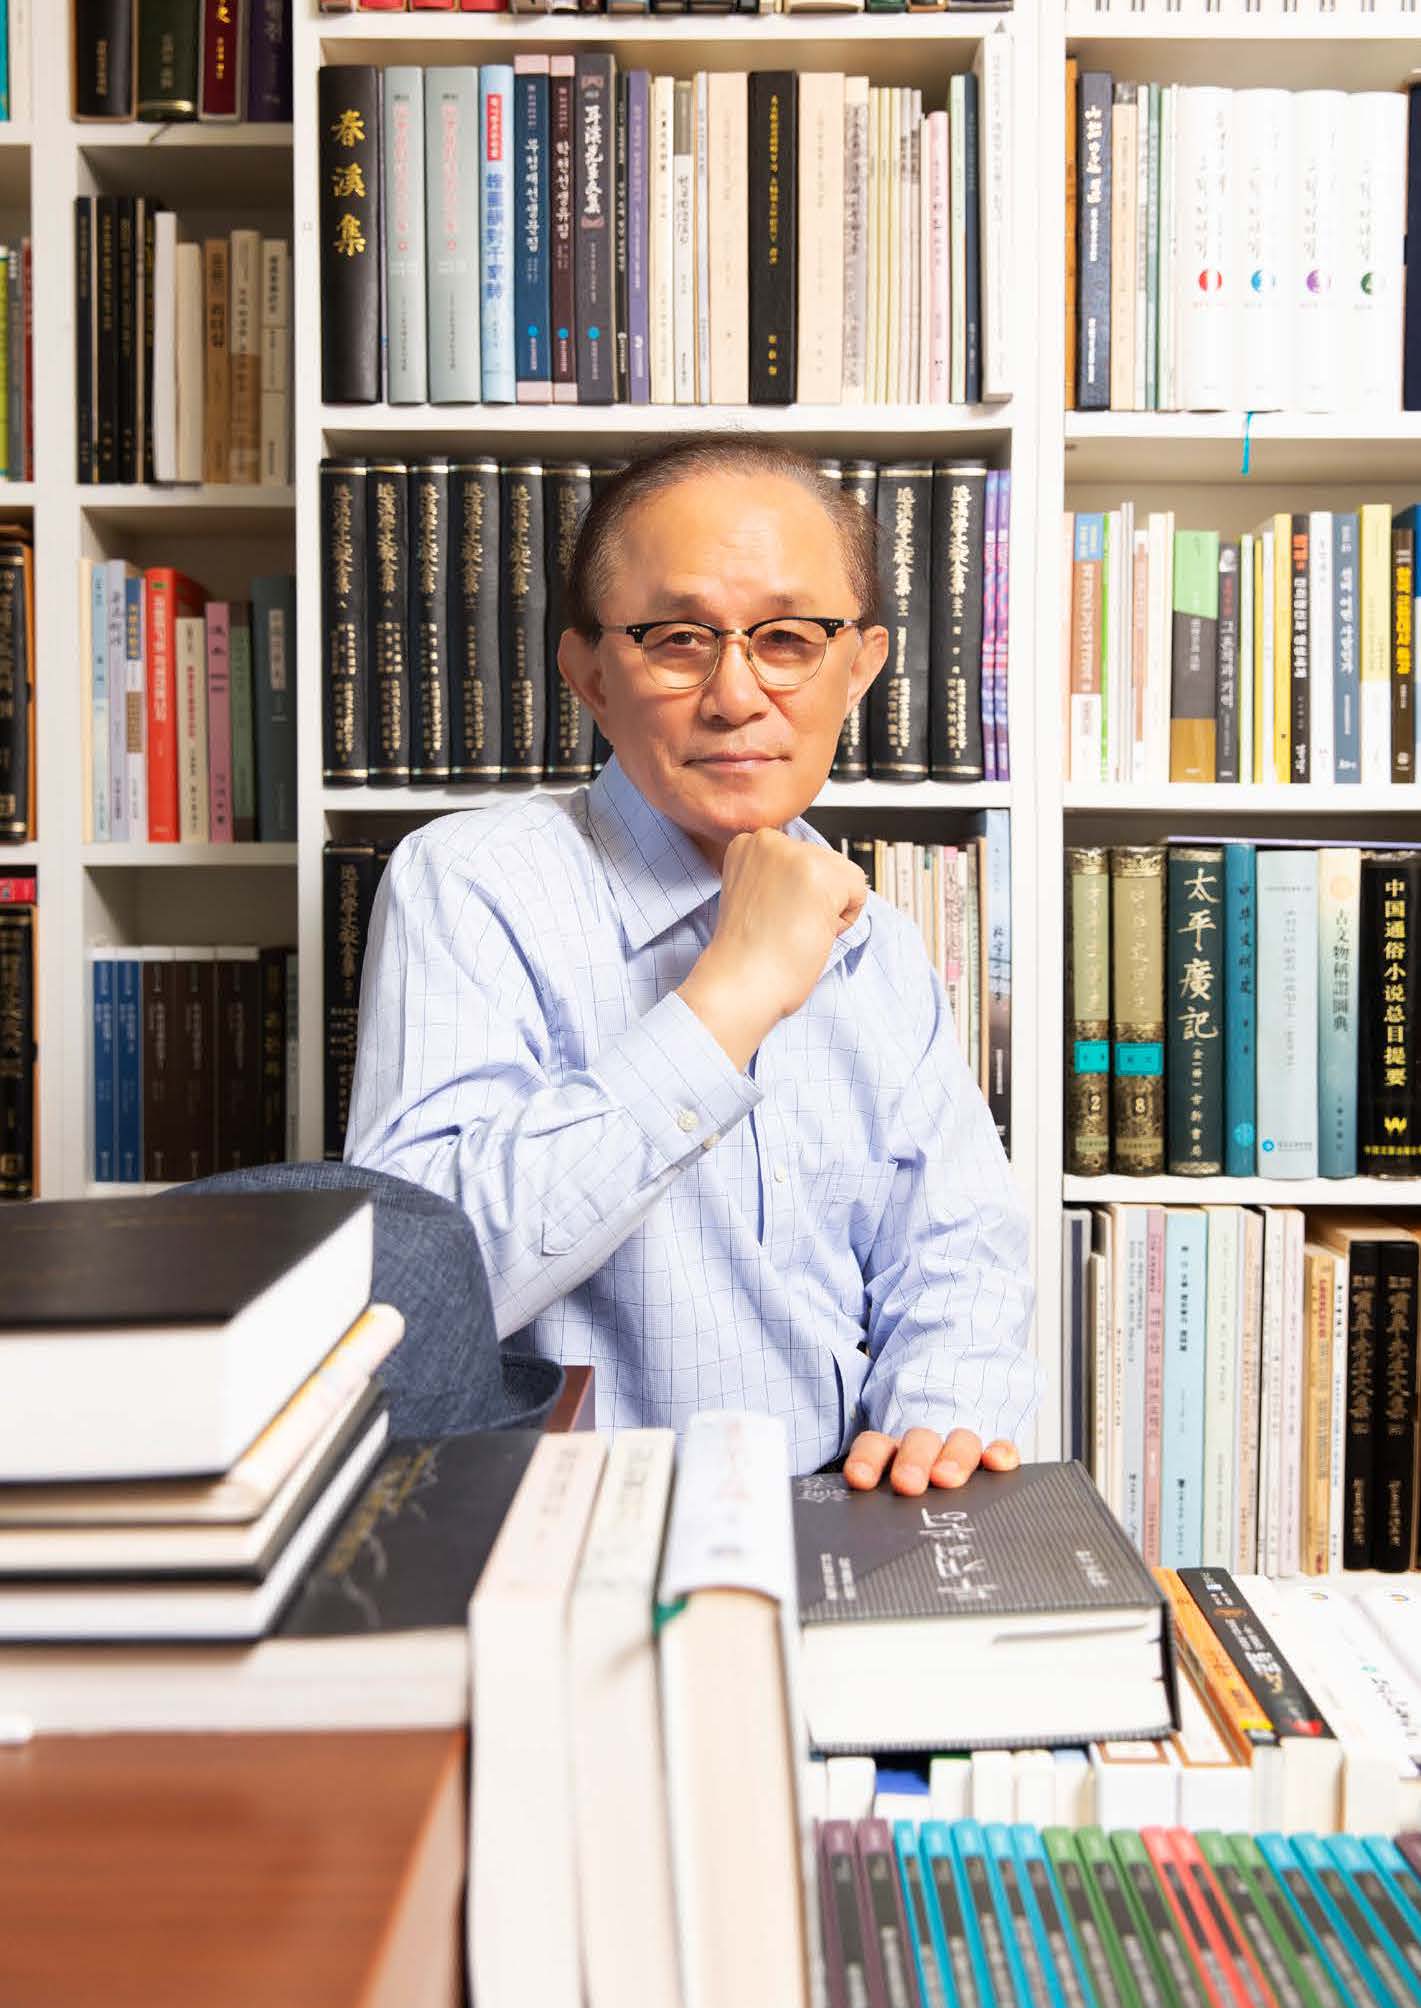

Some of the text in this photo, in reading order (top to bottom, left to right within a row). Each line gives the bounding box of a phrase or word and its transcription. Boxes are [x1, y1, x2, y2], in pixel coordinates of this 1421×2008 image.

[1177, 867, 1221, 1042] 太平廣記
[1383, 878, 1408, 1088] 中国通俗小说总目提要
[1090, 1095, 1101, 1111] 2
[1135, 1097, 1145, 1113] 8
